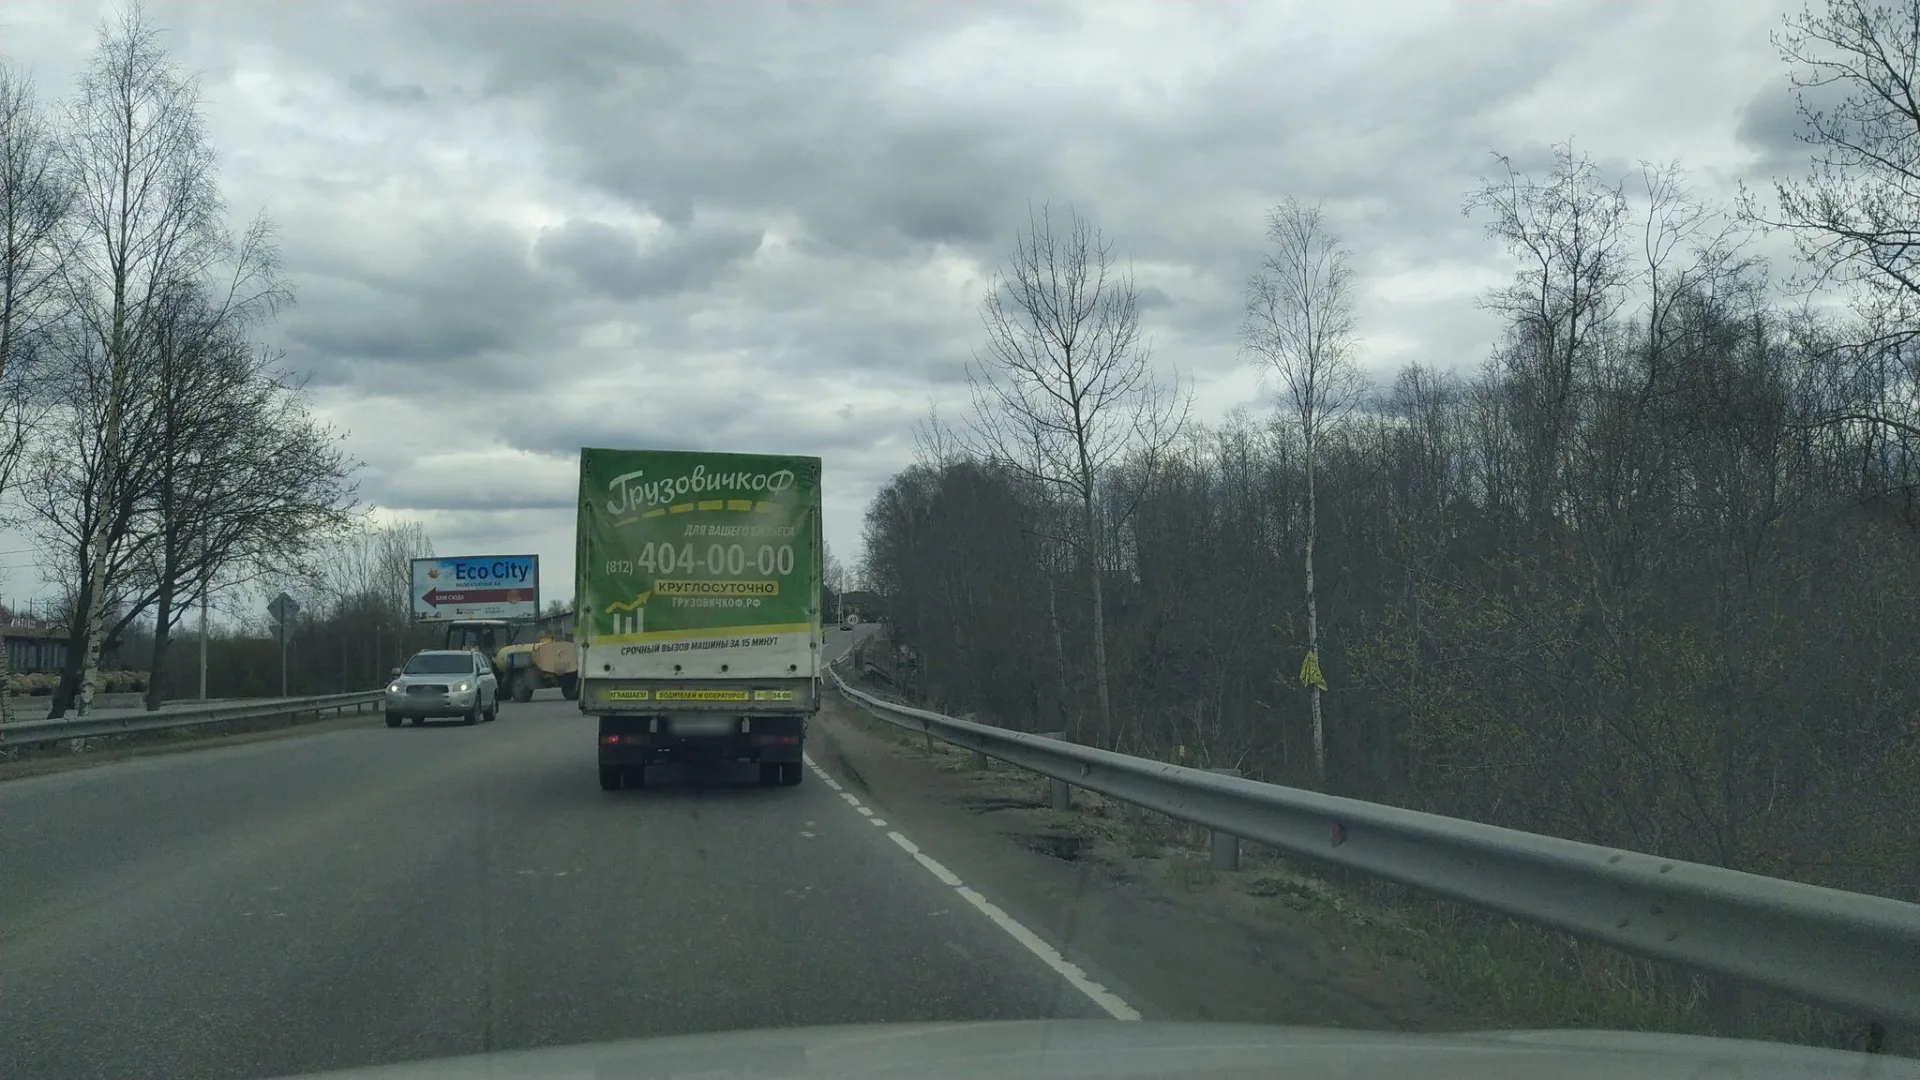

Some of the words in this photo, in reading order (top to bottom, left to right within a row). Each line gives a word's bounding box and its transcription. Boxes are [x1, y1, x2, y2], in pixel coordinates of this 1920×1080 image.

[684, 524, 706, 537] ДЛЯ
[707, 525, 750, 538] ВАШЕГО
[605, 560, 634, 576] (812)
[638, 542, 795, 576] 404-00-00
[455, 563, 489, 580] Eco
[492, 561, 529, 582] City
[658, 582, 774, 593] КРУГЛОСУТОЧНО
[672, 597, 761, 608] ГРУЗОВИЧКОФ.РФ
[620, 643, 660, 656] СРОЧНЫЙ
[661, 642, 690, 653] ВЫЗОВ
[690, 638, 728, 651] МАШИНЫ
[729, 638, 741, 648] ЗА
[741, 638, 751, 647] 15
[751, 636, 779, 647] МИНУТ
[611, 691, 647, 699] ГЛАШАЕМ
[659, 691, 697, 700] ВОДИТЕЛЕЙ
